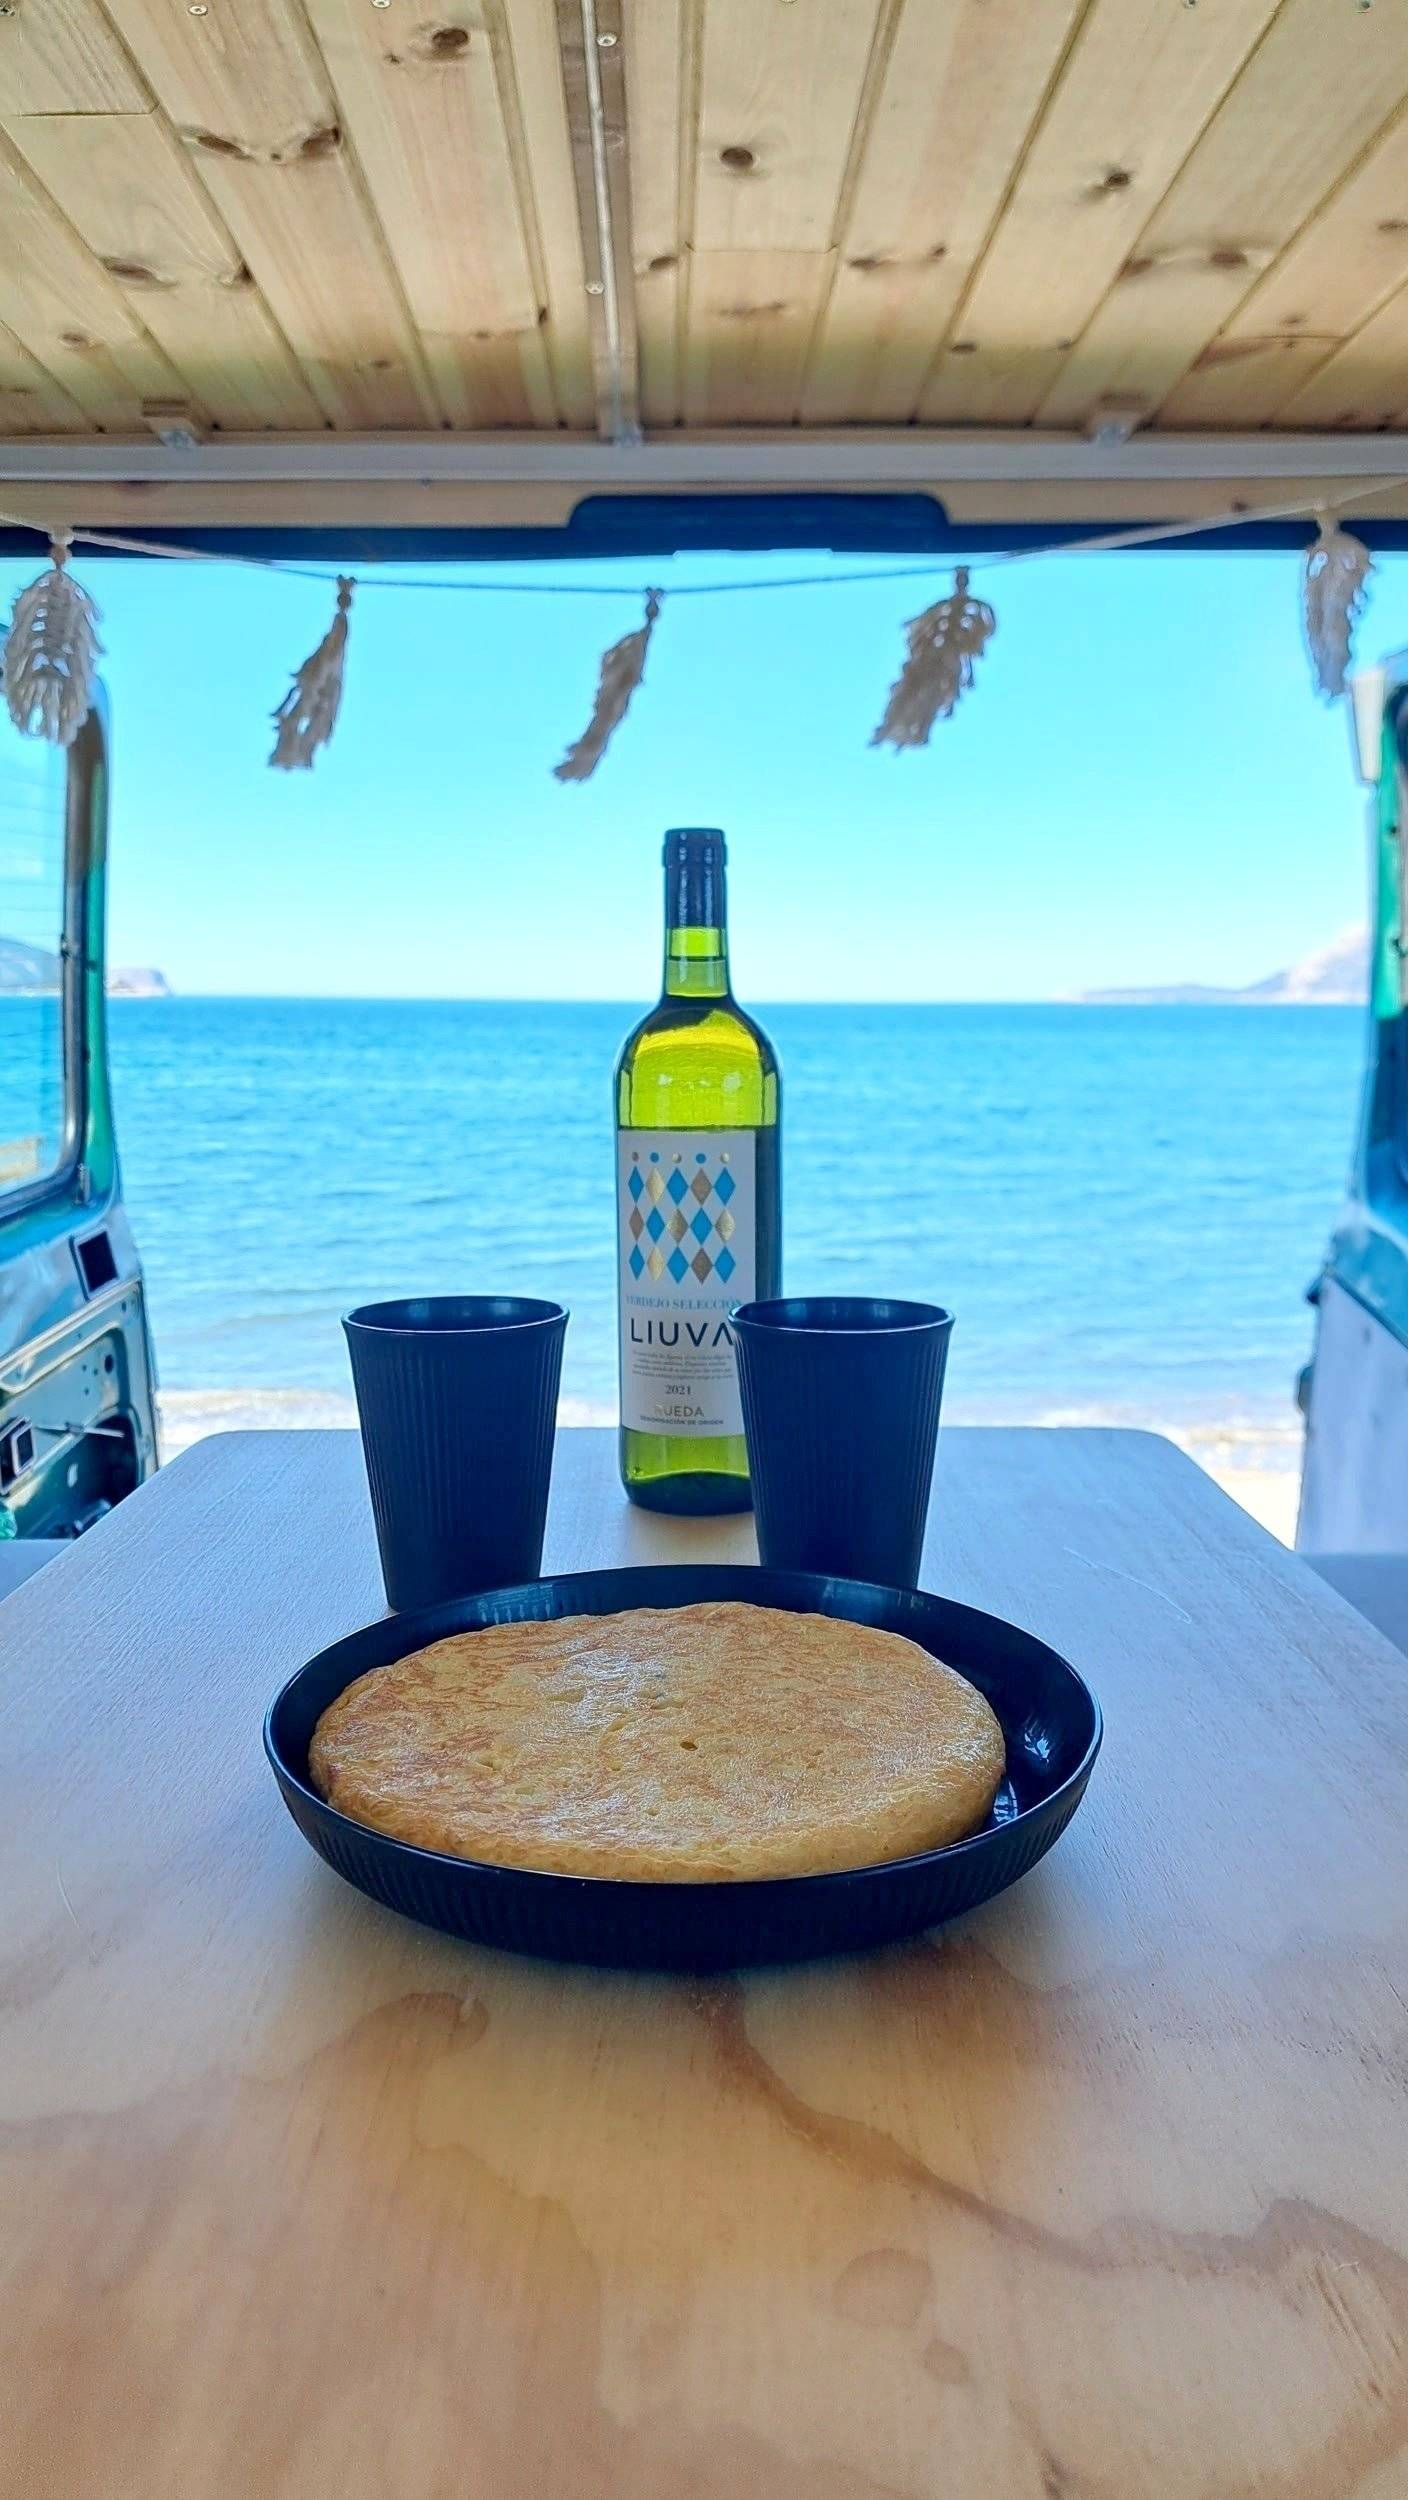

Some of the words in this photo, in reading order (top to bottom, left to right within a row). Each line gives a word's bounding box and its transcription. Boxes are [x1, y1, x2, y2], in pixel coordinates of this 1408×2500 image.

[626, 1295, 669, 1308] VERDEJO
[631, 1318, 734, 1347] LIUVA
[665, 1384, 692, 1396] 2021
